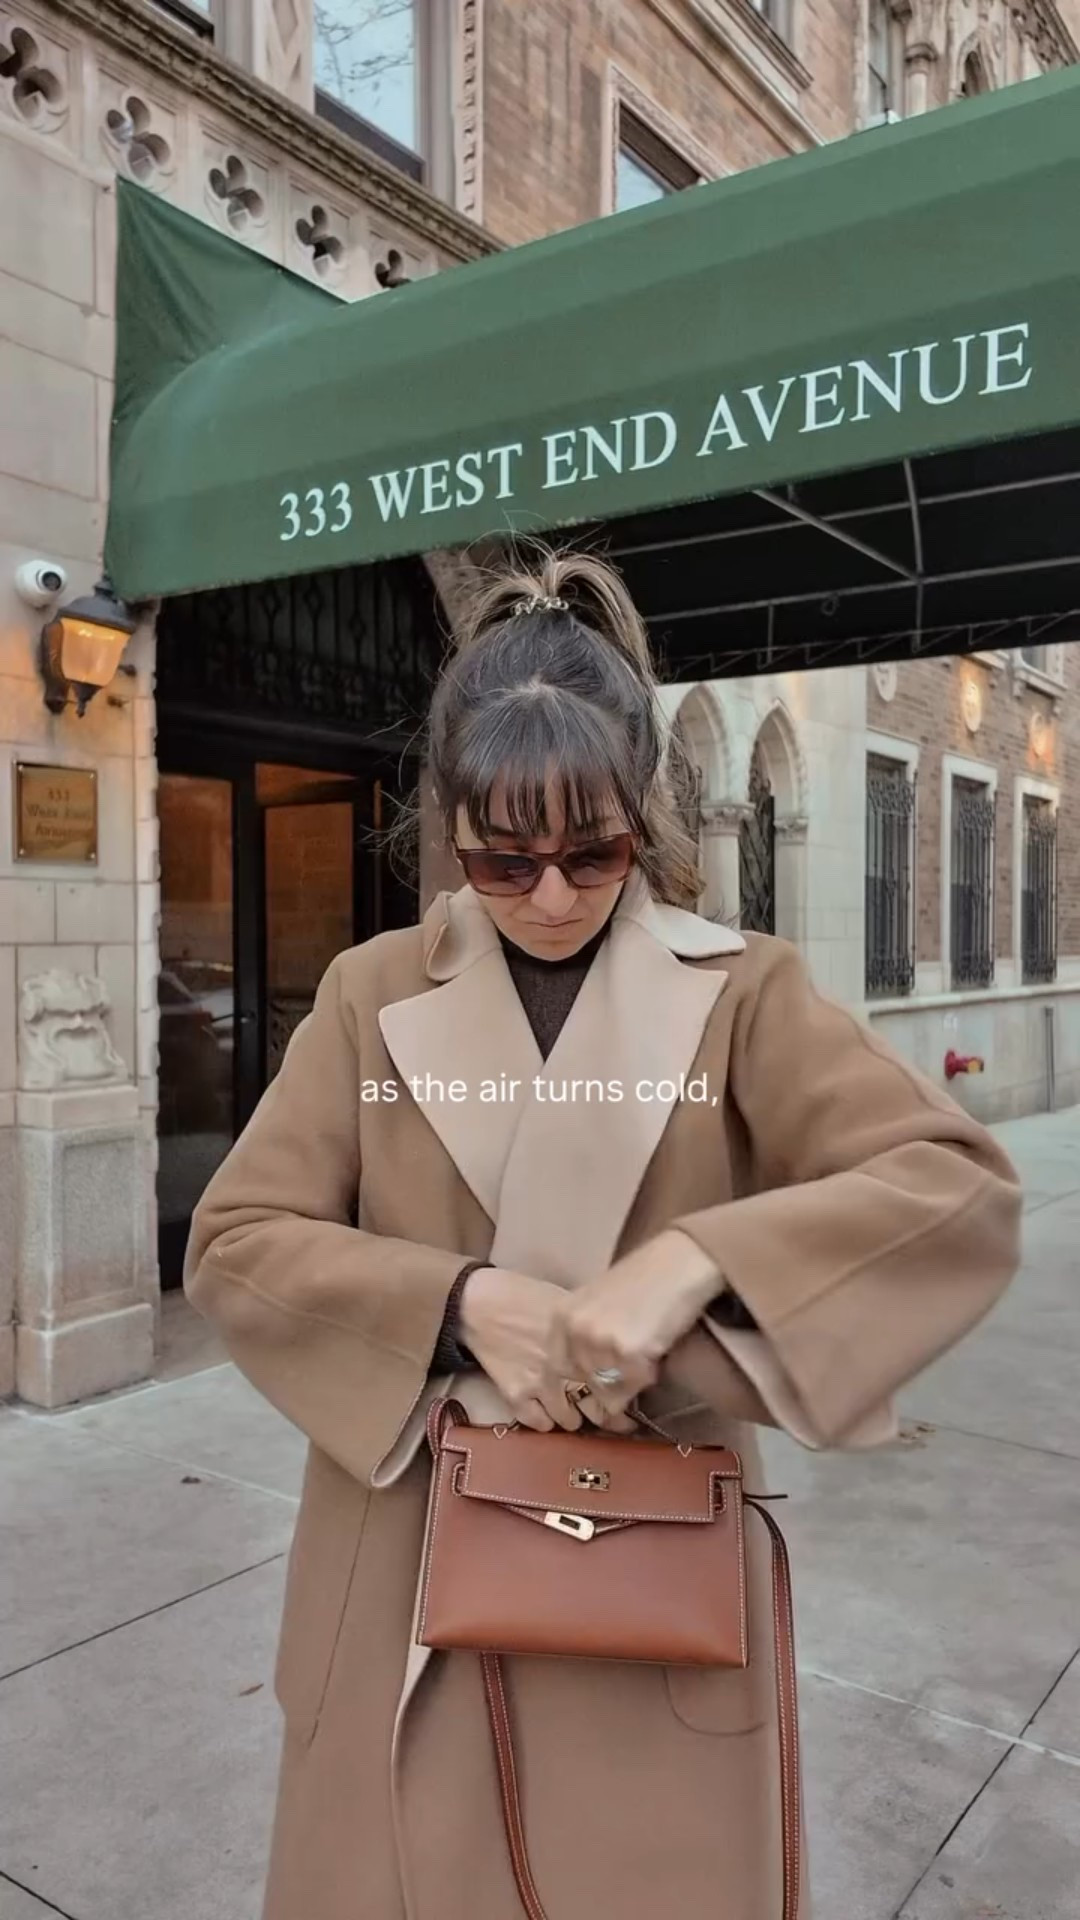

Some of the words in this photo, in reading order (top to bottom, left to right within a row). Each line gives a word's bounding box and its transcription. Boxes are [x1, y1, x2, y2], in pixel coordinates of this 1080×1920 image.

[279, 482, 352, 541] 333
[368, 443, 523, 523] WEST
[541, 411, 678, 490] END
[696, 322, 1032, 456] AVENUE
